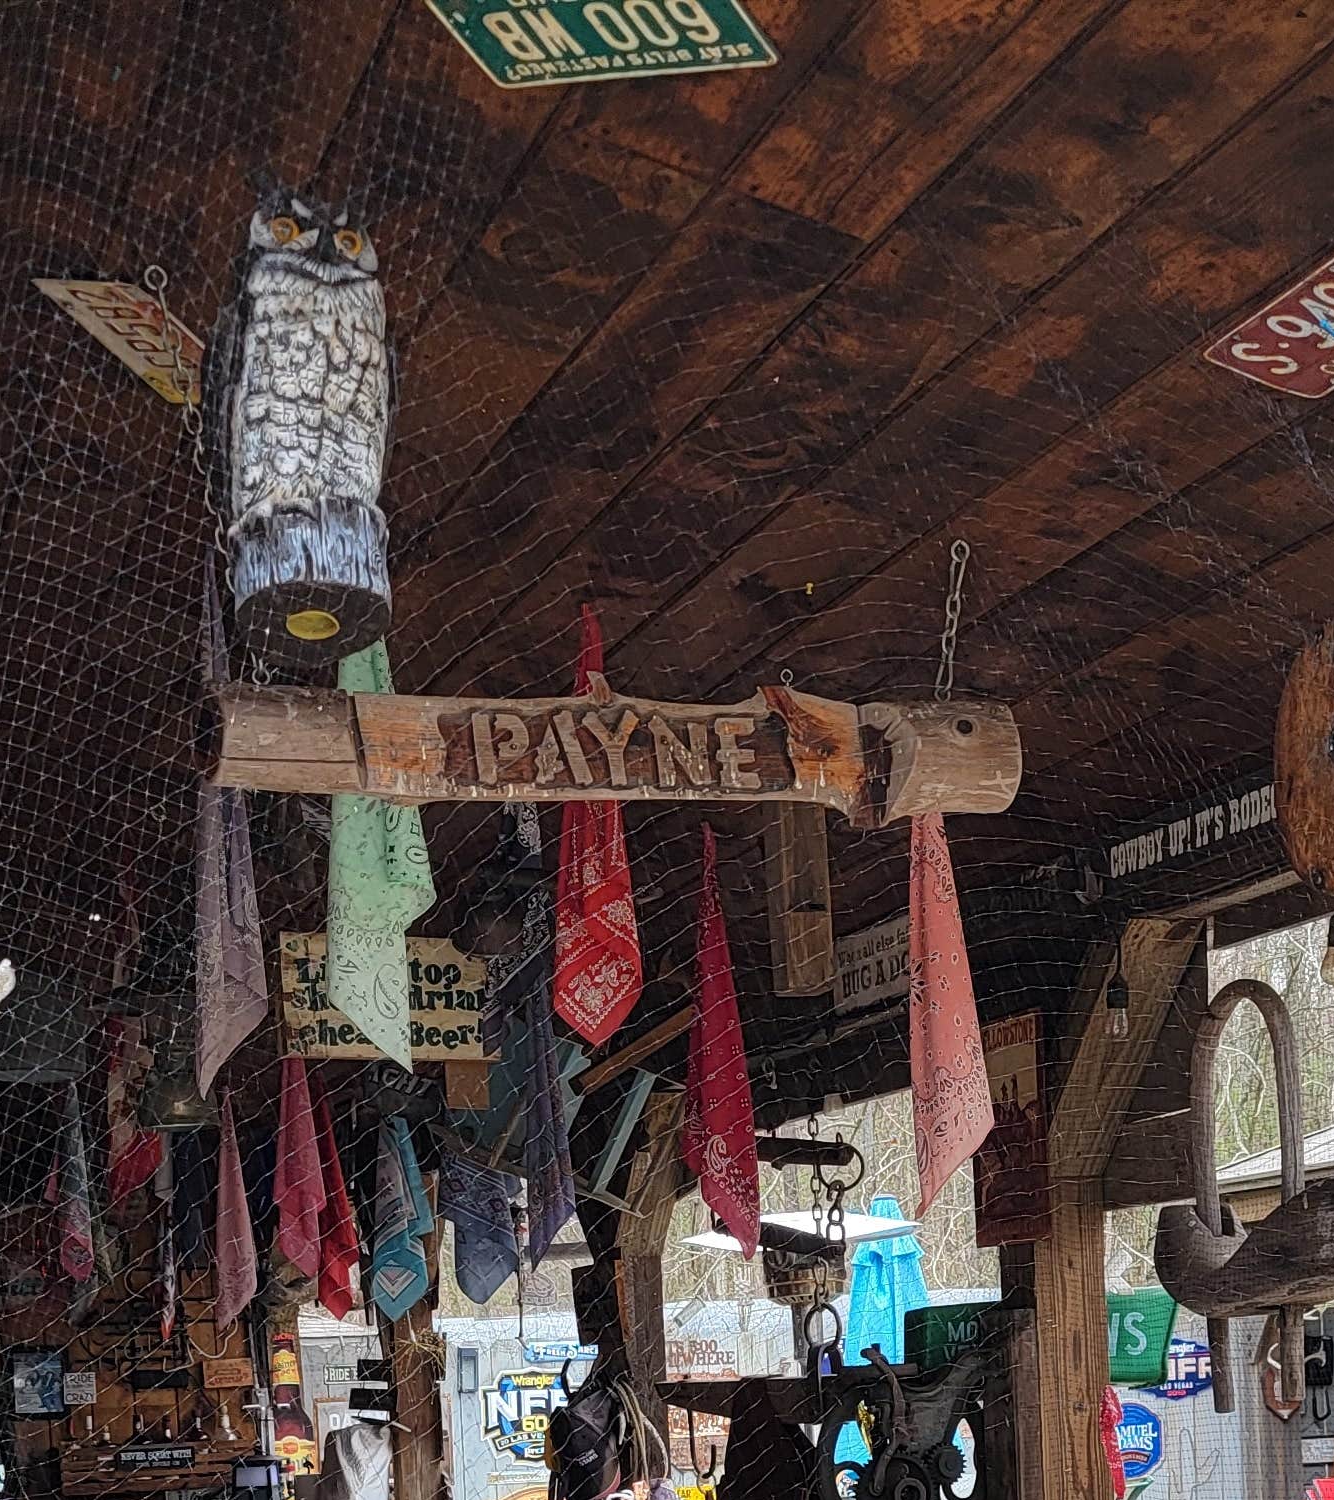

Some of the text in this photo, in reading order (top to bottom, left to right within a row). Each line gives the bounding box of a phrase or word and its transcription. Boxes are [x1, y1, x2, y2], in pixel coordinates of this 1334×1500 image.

[482, 0, 720, 60] 600 WB
[698, 43, 754, 60] SEAT
[470, 708, 763, 790] PAYNE
[1110, 827, 1164, 879] COWBOY
[1168, 816, 1193, 857] UP!
[1195, 804, 1225, 848] IT'S
[841, 961, 872, 1000] HUG
[873, 957, 888, 988] A
[982, 1017, 1036, 1051] ELLOWSTONE
[1168, 1342, 1196, 1358] ngler
[511, 1374, 556, 1389] Wrangler
[522, 1414, 548, 1432] 60
[1114, 1421, 1158, 1439] AMUEL
[1117, 1435, 1154, 1451] DAMS
